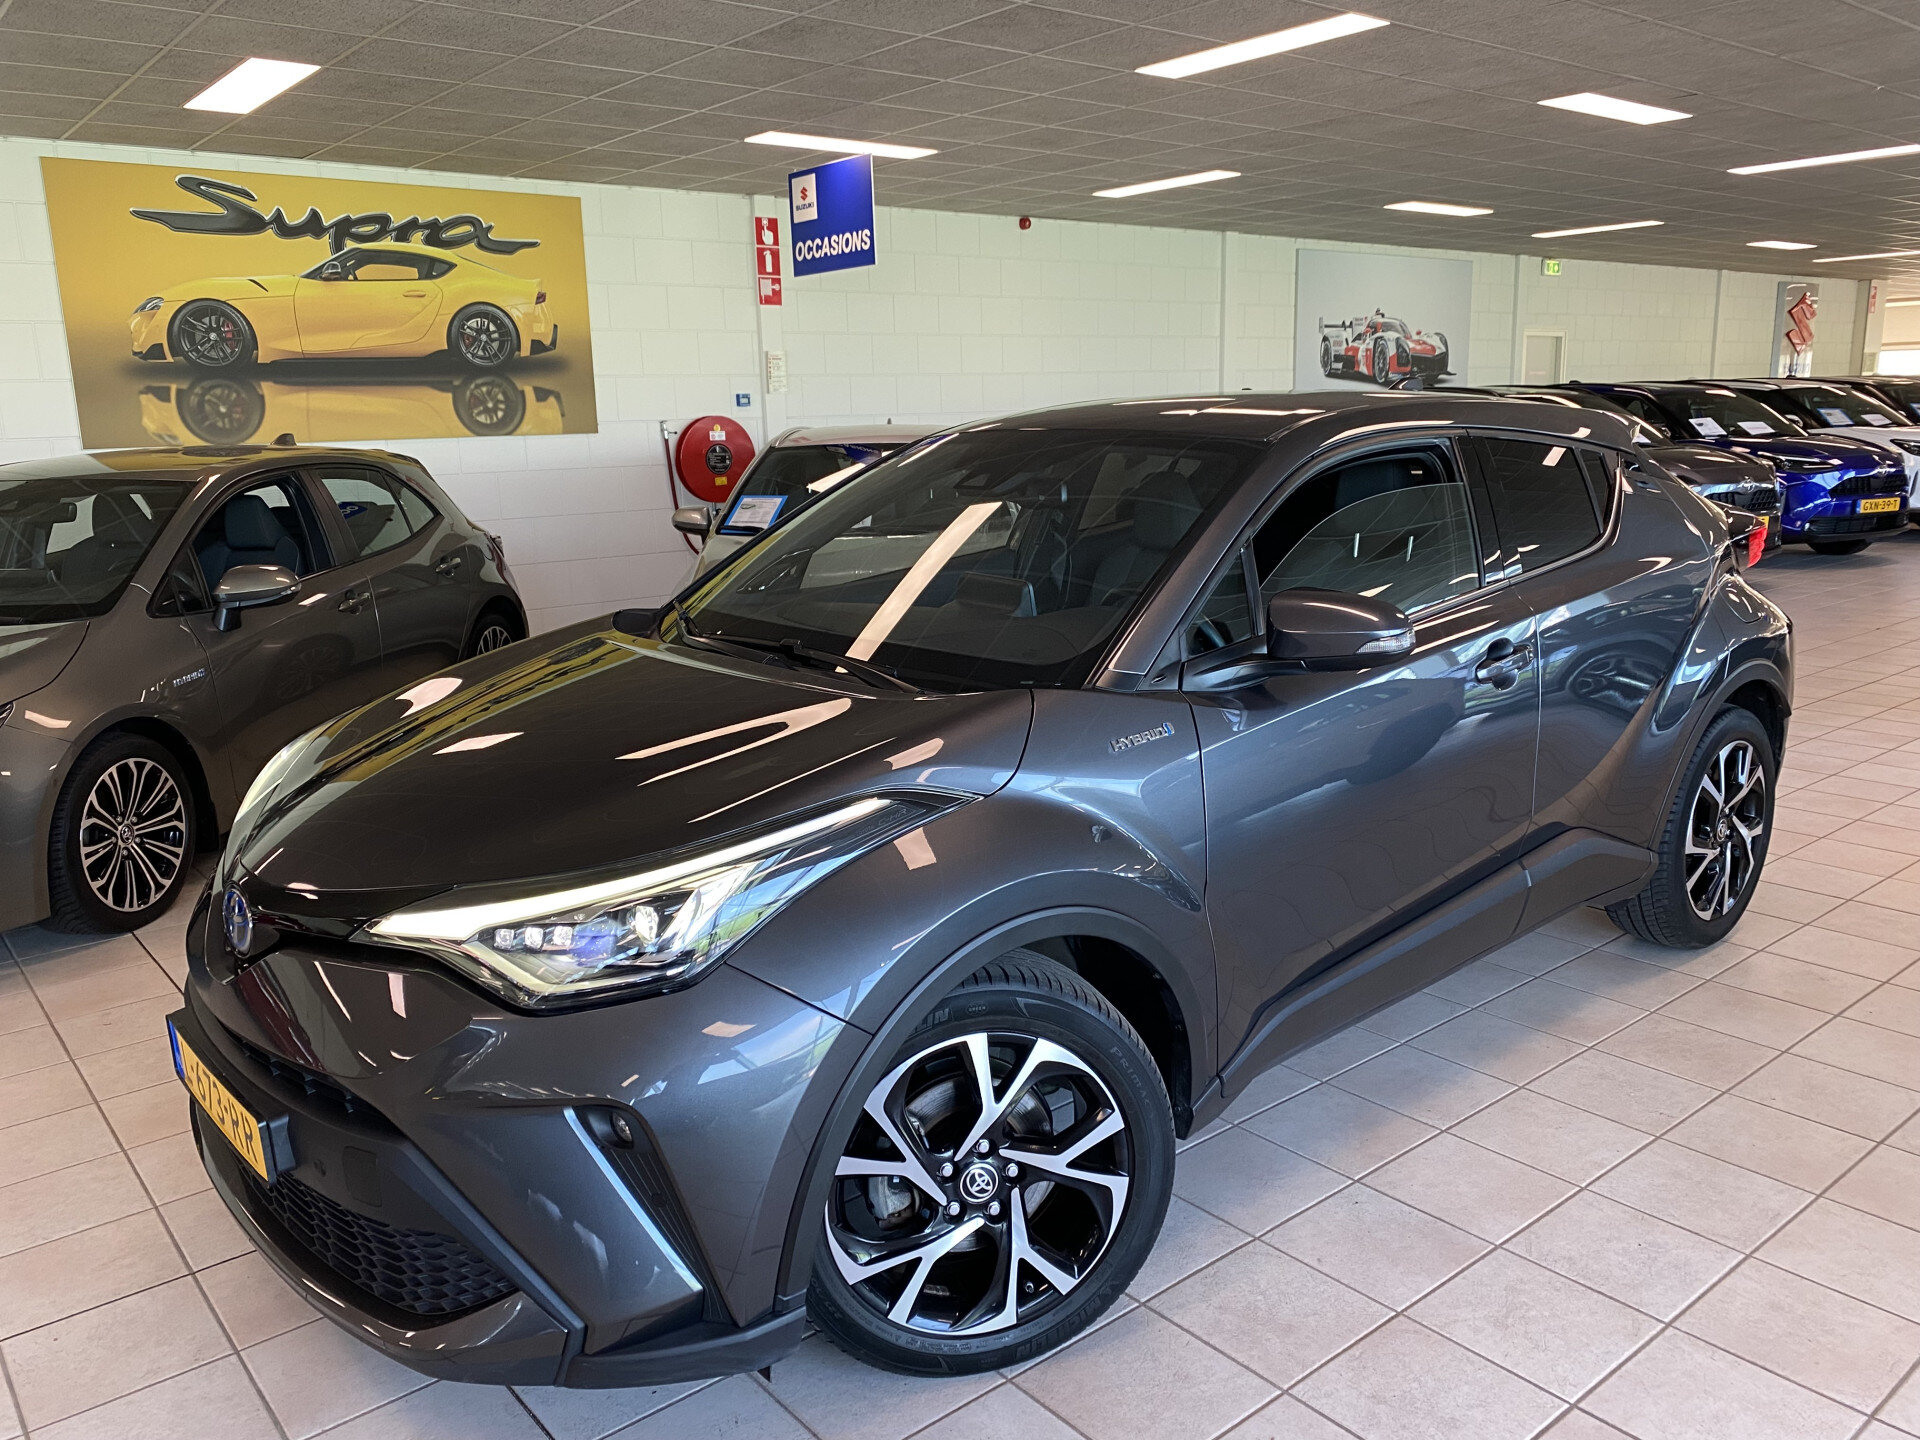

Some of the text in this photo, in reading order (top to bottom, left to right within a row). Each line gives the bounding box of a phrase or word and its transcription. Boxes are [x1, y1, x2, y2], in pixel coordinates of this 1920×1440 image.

[129, 174, 541, 256] Supra
[795, 201, 815, 212] SUZUKI
[795, 229, 871, 262] OCCASIONS
[1863, 499, 1898, 511] GXN-39-T
[1110, 725, 1171, 752] HYBRID
[181, 1041, 258, 1165] L-673-RR
